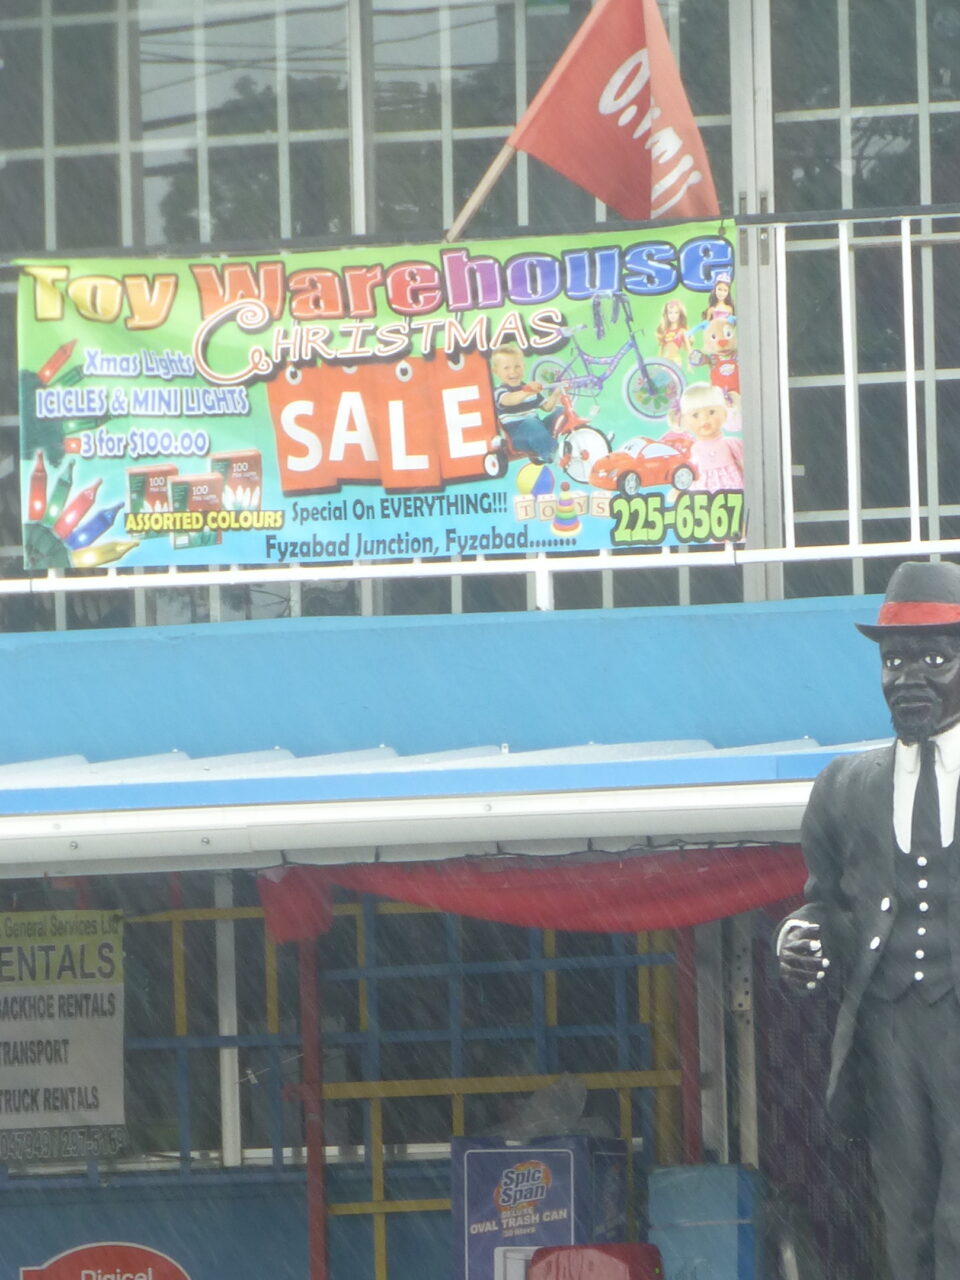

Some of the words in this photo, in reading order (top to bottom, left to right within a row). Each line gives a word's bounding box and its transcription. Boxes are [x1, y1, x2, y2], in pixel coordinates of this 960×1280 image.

[24, 266, 179, 330] Toy
[189, 235, 735, 320] Warehouse
[193, 298, 564, 385] CHRISTMAS
[83, 348, 140, 377] Xmas
[141, 349, 196, 380] Lights
[36, 388, 107, 418] ICICLES
[110, 388, 128, 415] &
[131, 387, 181, 416] MINI
[184, 385, 249, 416] LIGHTS
[280, 385, 488, 472] SALE
[80, 430, 93, 459] 3
[95, 430, 126, 458] for
[128, 427, 209, 457] $100.00
[232, 462, 249, 472] 100
[150, 477, 165, 487] 100
[192, 485, 209, 495] 100
[125, 512, 204, 532] ASSORTED
[206, 510, 284, 530] COLOURS
[292, 499, 348, 525] Special
[352, 499, 375, 520] On
[380, 492, 508, 519] EVERYTHING!!!
[613, 493, 744, 543] 225-6567
[265, 533, 350, 563] Fyzabad
[355, 531, 440, 558] Junction,
[5, 916, 47, 938] General
[50, 914, 98, 937] Services
[0, 994, 55, 1019] ACKHOE
[58, 992, 116, 1018] RENTALS
[43, 1086, 100, 1112] RENTALS
[503, 1168, 542, 1188] Spic
[501, 1184, 546, 1206] Span
[470, 1221, 498, 1235] OVAL
[502, 1213, 540, 1229] TRASH
[543, 1208, 568, 1222] CAN
